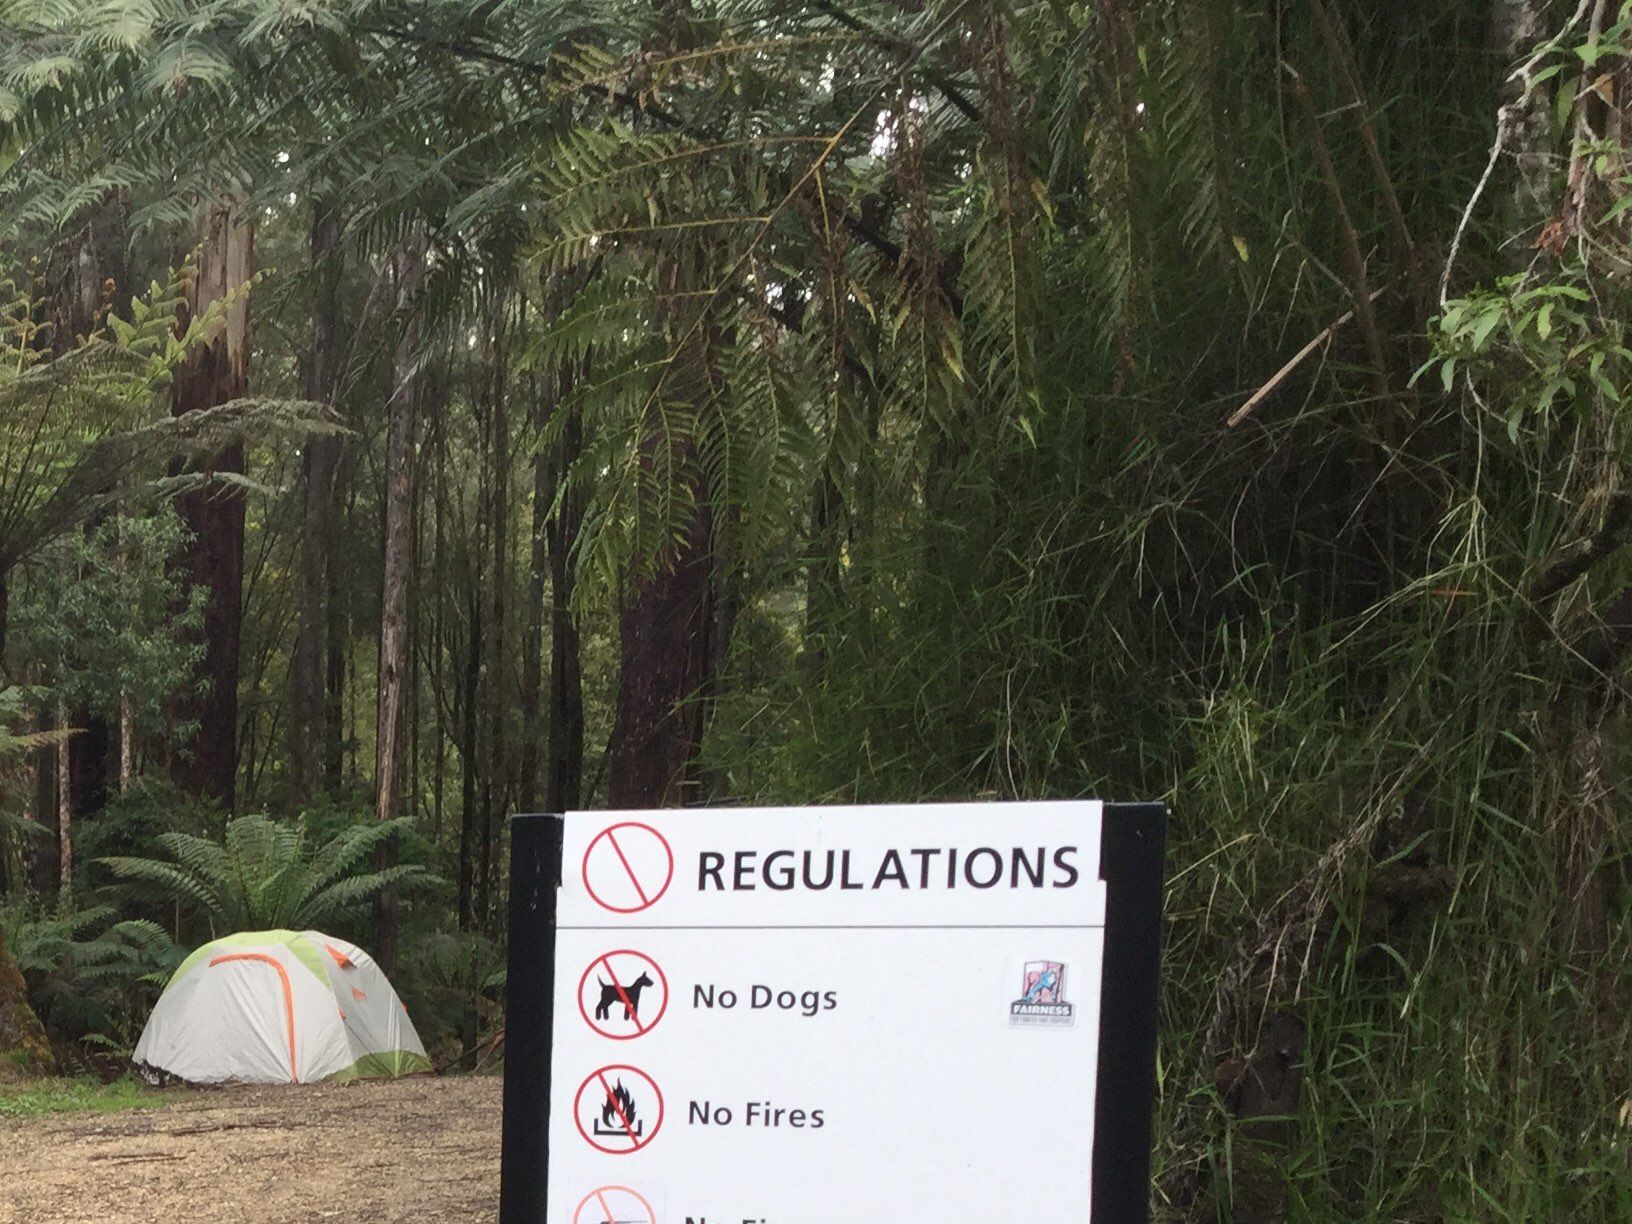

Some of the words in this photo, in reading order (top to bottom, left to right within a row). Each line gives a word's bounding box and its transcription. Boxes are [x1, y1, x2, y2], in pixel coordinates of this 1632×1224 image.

[697, 845, 1080, 892] REGULATIONS
[693, 984, 737, 1010] No
[750, 984, 838, 1017] Dogs
[1013, 1004, 1070, 1016] FAIRNESS
[689, 1101, 733, 1127] No
[746, 1101, 825, 1129] Fires
